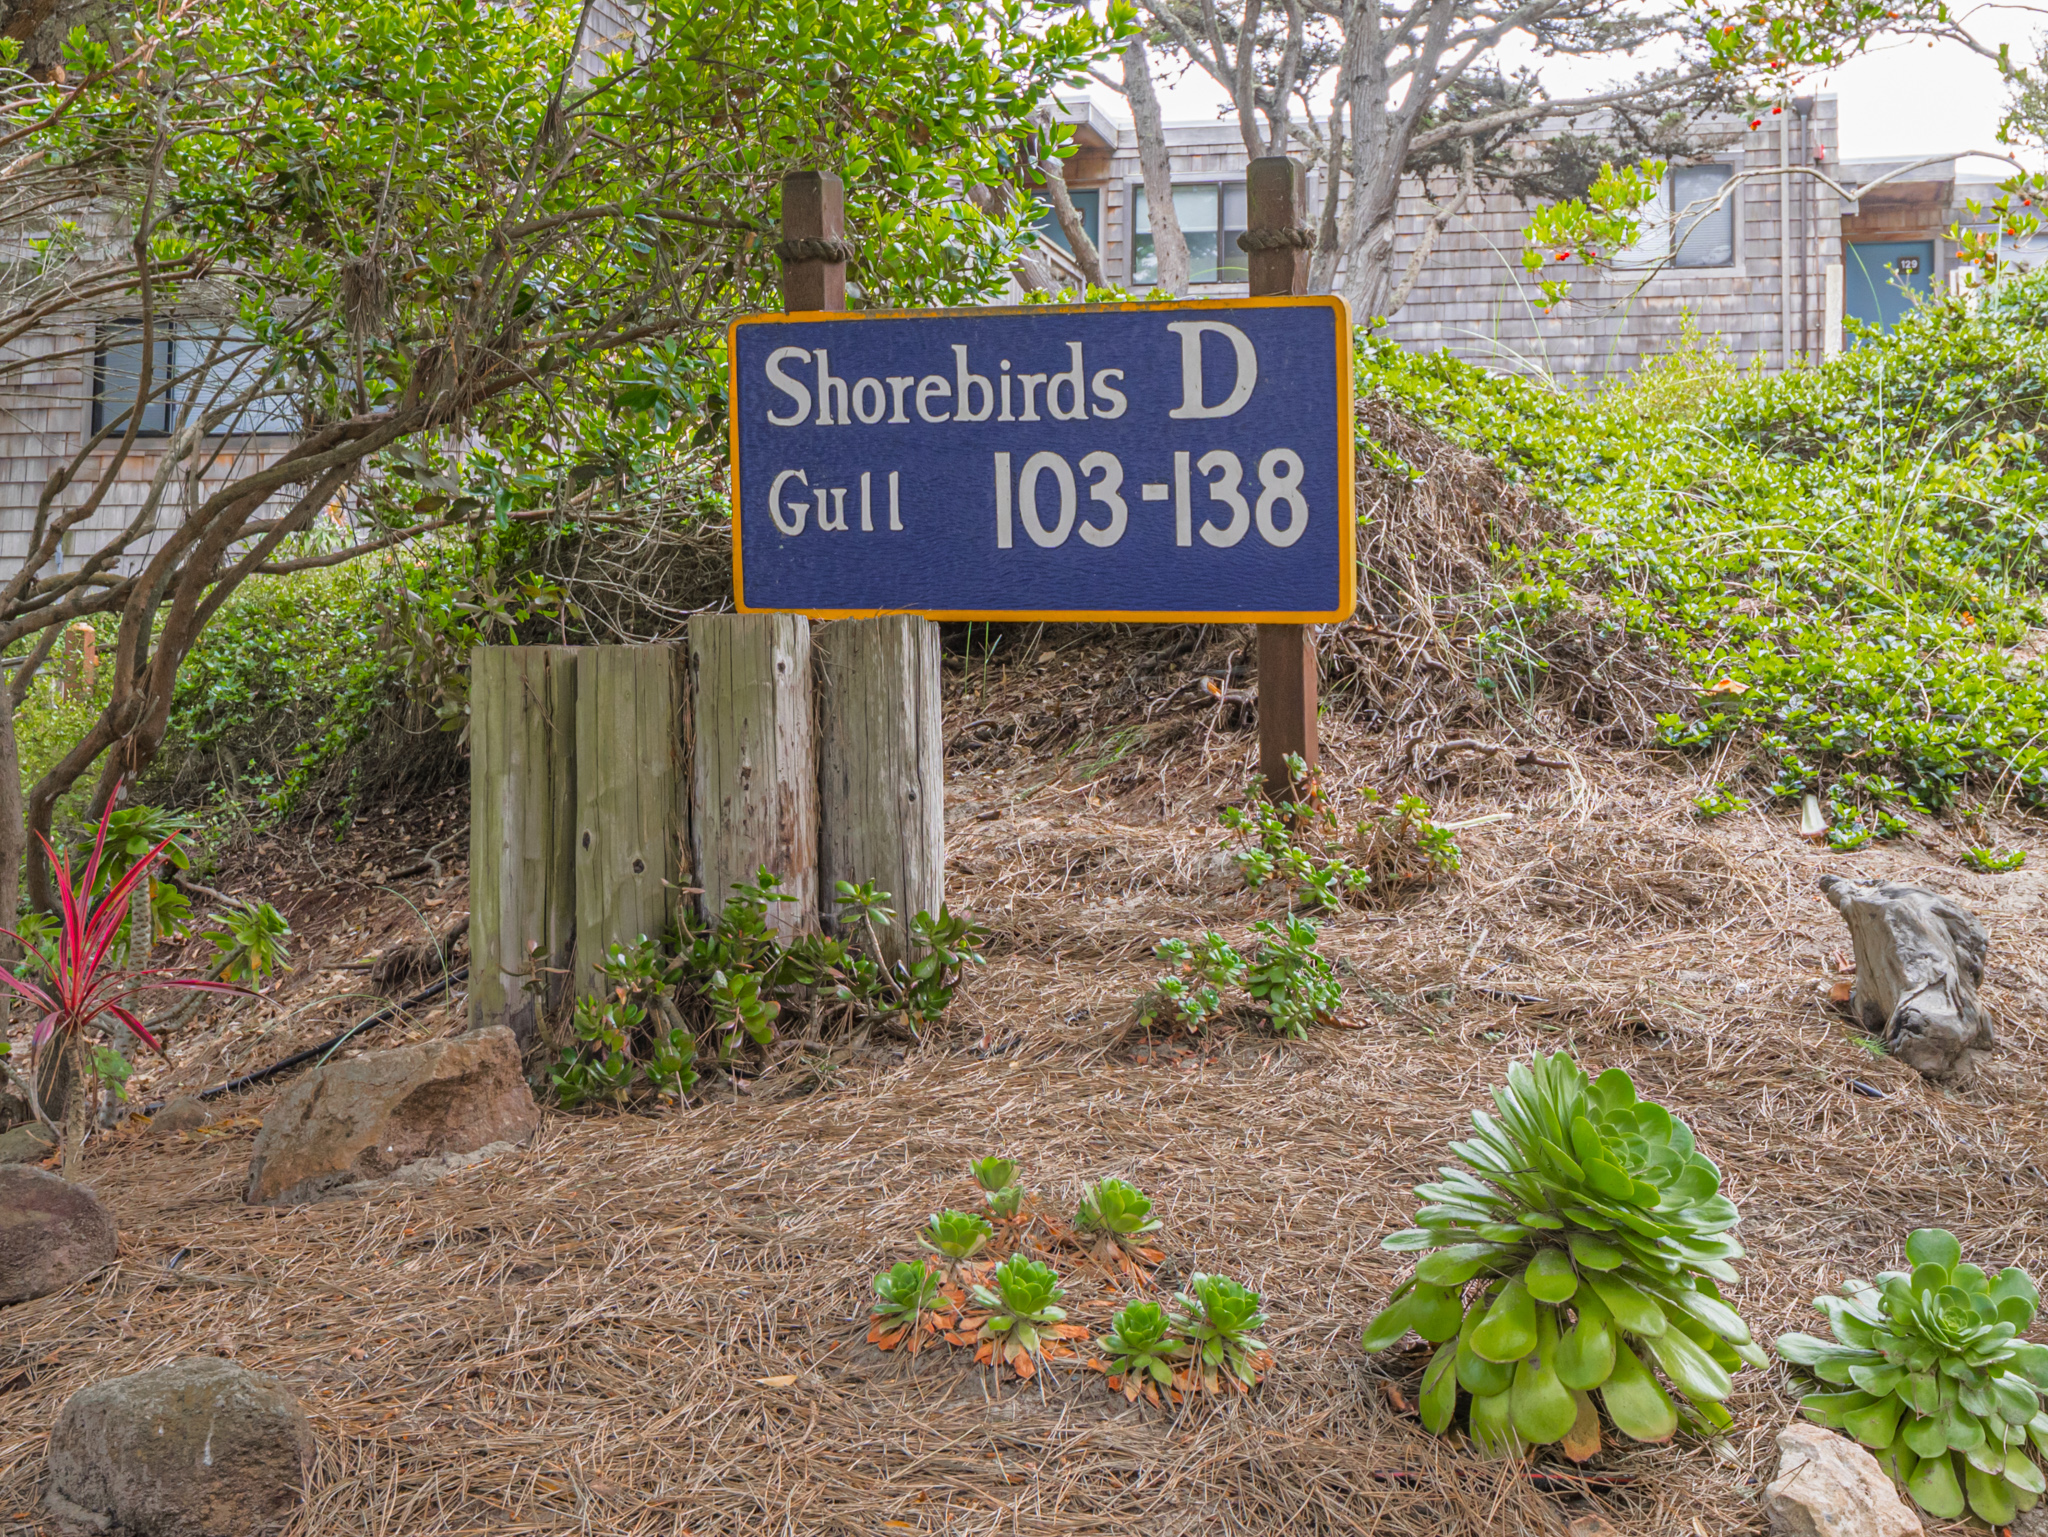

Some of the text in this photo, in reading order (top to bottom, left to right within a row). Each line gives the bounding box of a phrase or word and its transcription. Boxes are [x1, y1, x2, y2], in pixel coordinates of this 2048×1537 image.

[1901, 260, 1918, 269] 129
[765, 321, 1257, 426] Shorebirds D
[768, 448, 1309, 549] Gull 103-138
